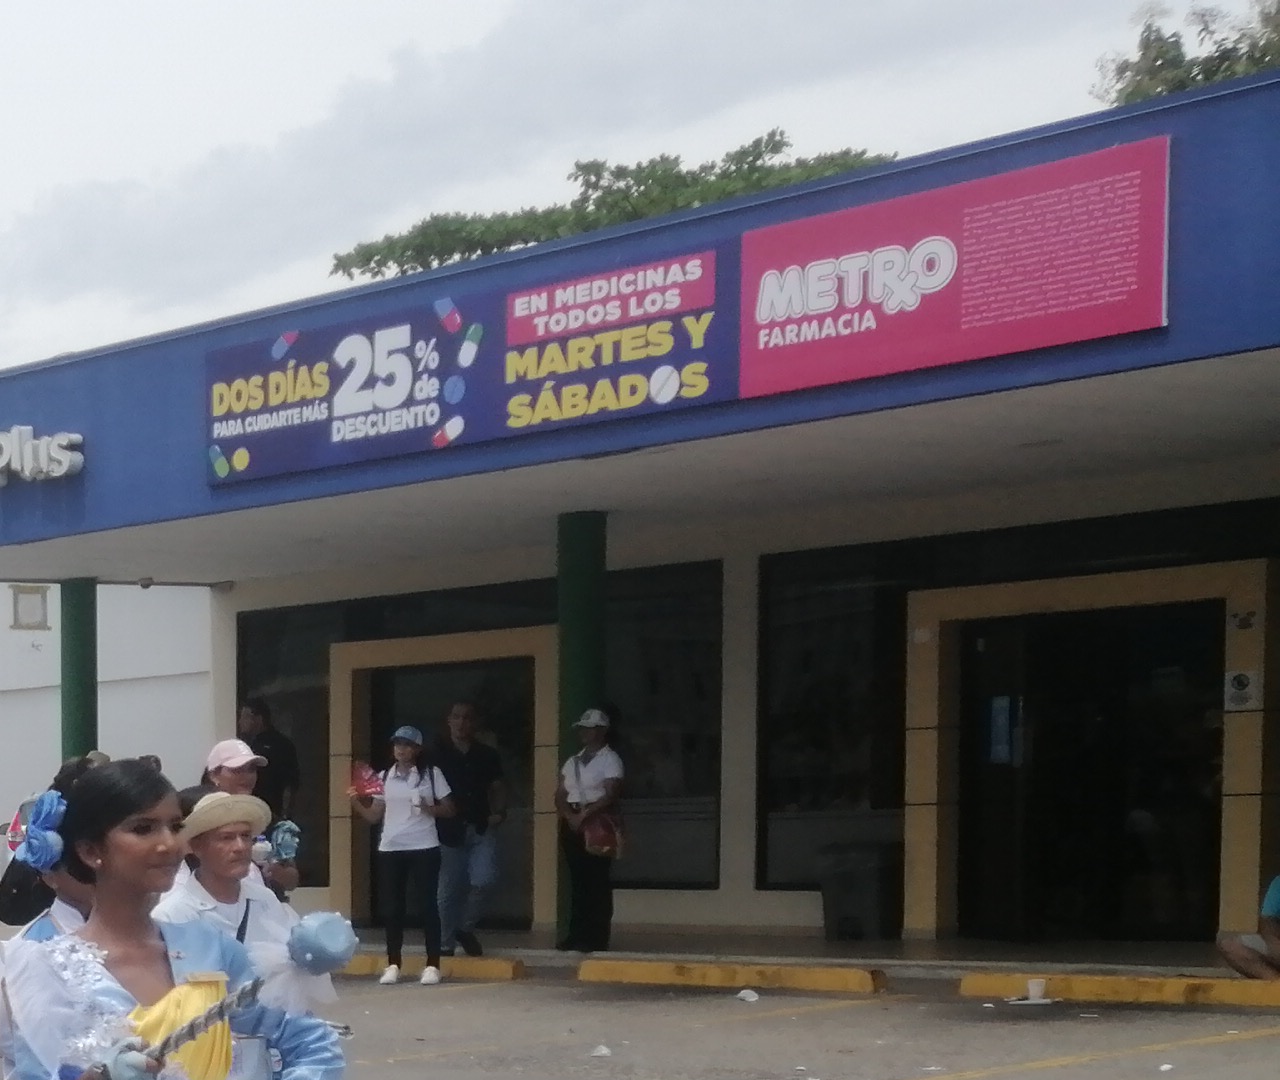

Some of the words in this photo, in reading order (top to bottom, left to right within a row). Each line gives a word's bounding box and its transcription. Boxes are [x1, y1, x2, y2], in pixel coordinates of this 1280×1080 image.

[514, 292, 548, 318] EN
[555, 259, 703, 309] MEDICINAS
[755, 235, 958, 325] METRO
[533, 300, 622, 336] TODOS
[628, 288, 682, 318] LOS
[757, 309, 877, 350] FARMACIA
[505, 320, 675, 385] MARTES
[682, 311, 715, 349] Y
[212, 375, 265, 417] DOS
[268, 359, 331, 407] DÍAS
[413, 374, 440, 400] de
[506, 362, 710, 429] SÁBADOS
[213, 418, 245, 439] PARA
[244, 408, 300, 432] CUIDARTE
[301, 401, 329, 422] MÁS
[331, 403, 440, 442] DESCUENTO
